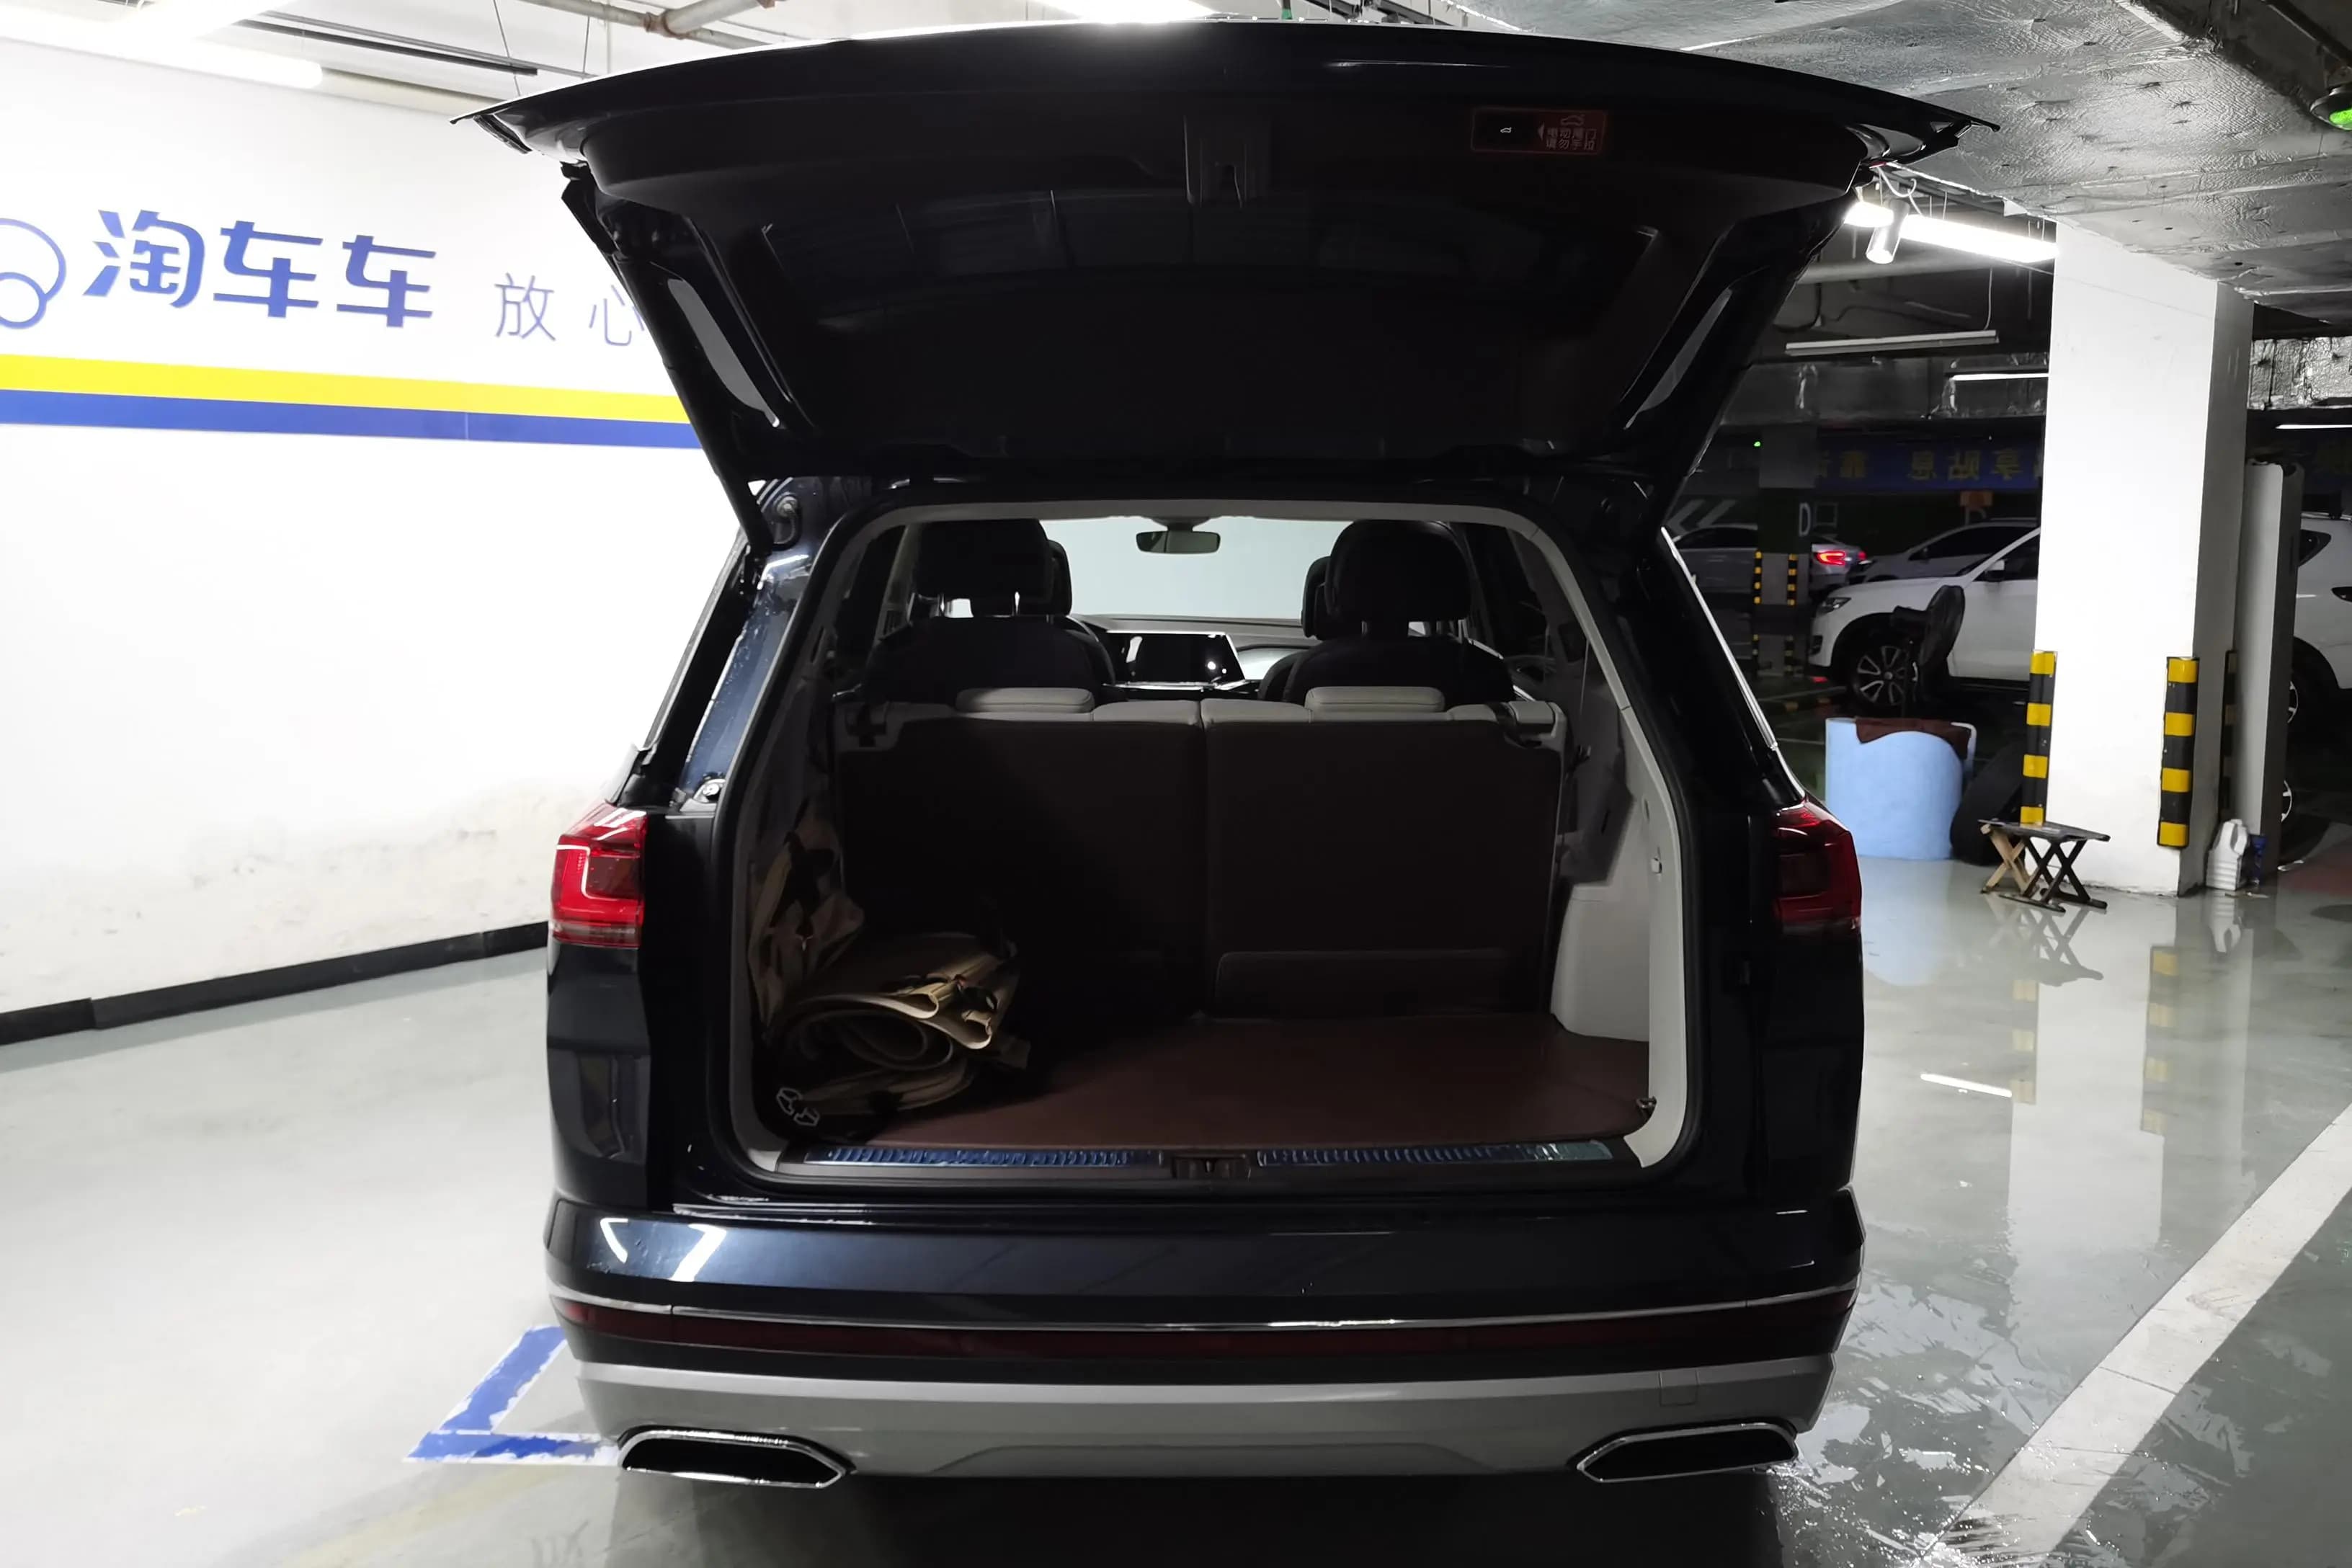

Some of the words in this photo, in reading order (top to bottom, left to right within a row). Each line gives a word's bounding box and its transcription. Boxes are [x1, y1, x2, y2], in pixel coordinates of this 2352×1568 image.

[83, 210, 436, 327] 淘车车
[494, 272, 644, 346] 放心
